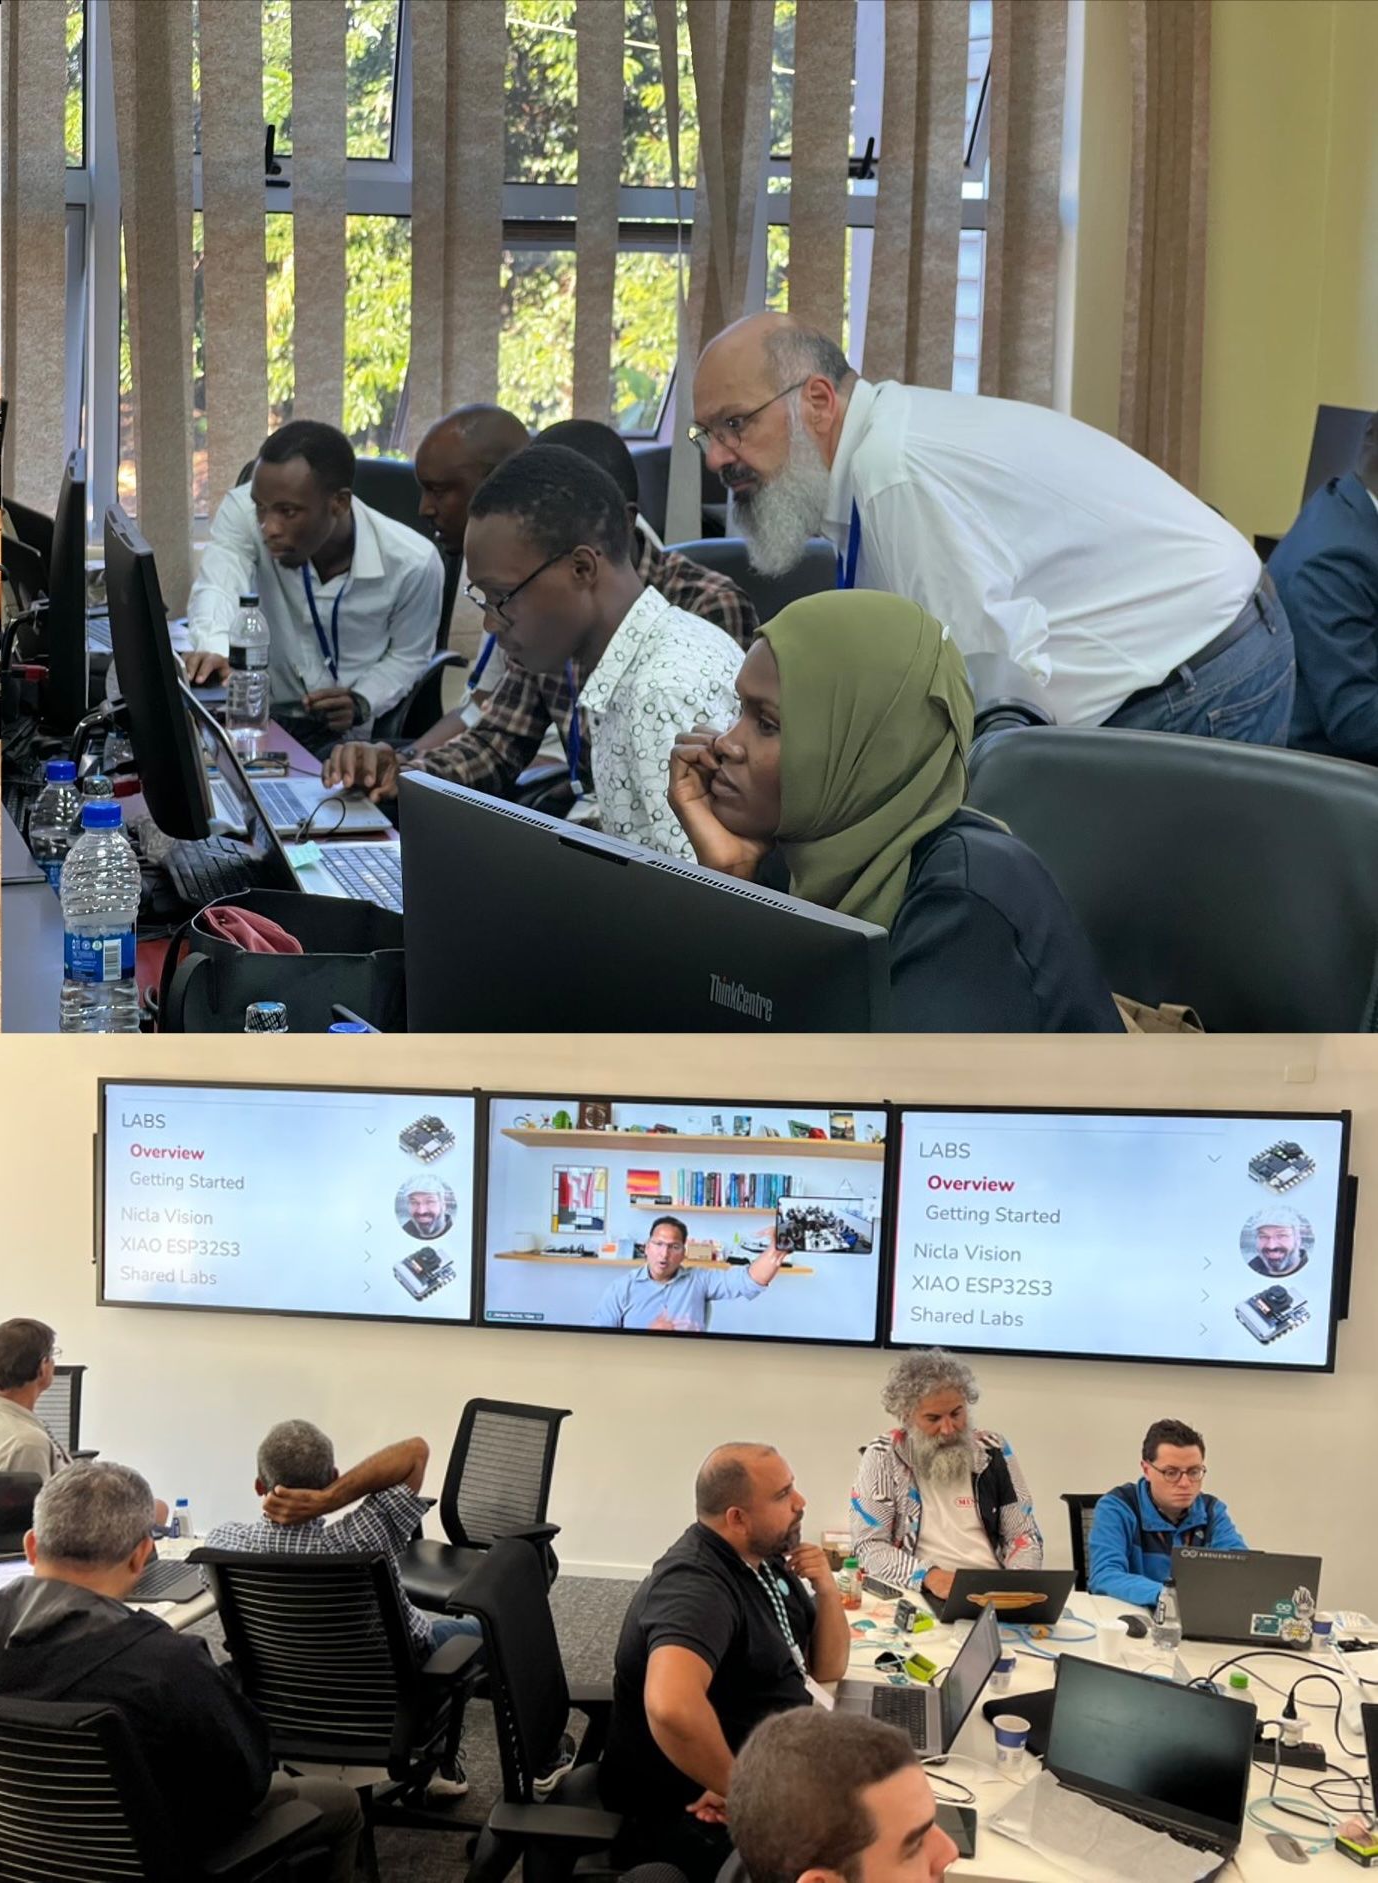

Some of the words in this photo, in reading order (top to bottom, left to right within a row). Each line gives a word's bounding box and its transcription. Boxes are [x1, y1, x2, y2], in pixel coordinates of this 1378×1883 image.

[710, 973, 773, 1022] ThinkCentre
[121, 1112, 167, 1130] LABS
[130, 1143, 205, 1161] Overview
[918, 1142, 971, 1160] LABS
[129, 1171, 184, 1190] Getting
[189, 1173, 245, 1190] Started
[927, 1174, 1015, 1194] Overview
[121, 1207, 160, 1224] Nicla
[164, 1208, 213, 1225] Vision
[925, 1205, 990, 1225] Getting
[995, 1207, 1061, 1225] Started
[120, 1236, 162, 1254] XIAO
[166, 1238, 241, 1257] ESP32S3
[913, 1242, 959, 1262] Nicla
[964, 1244, 1022, 1263] Vision
[120, 1266, 176, 1284] Shared
[179, 1269, 218, 1286] Labs
[912, 1275, 960, 1293] XIAO
[965, 1276, 1054, 1297] ESP32S3
[910, 1306, 974, 1326] Shared
[980, 1309, 1024, 1327] Labs
